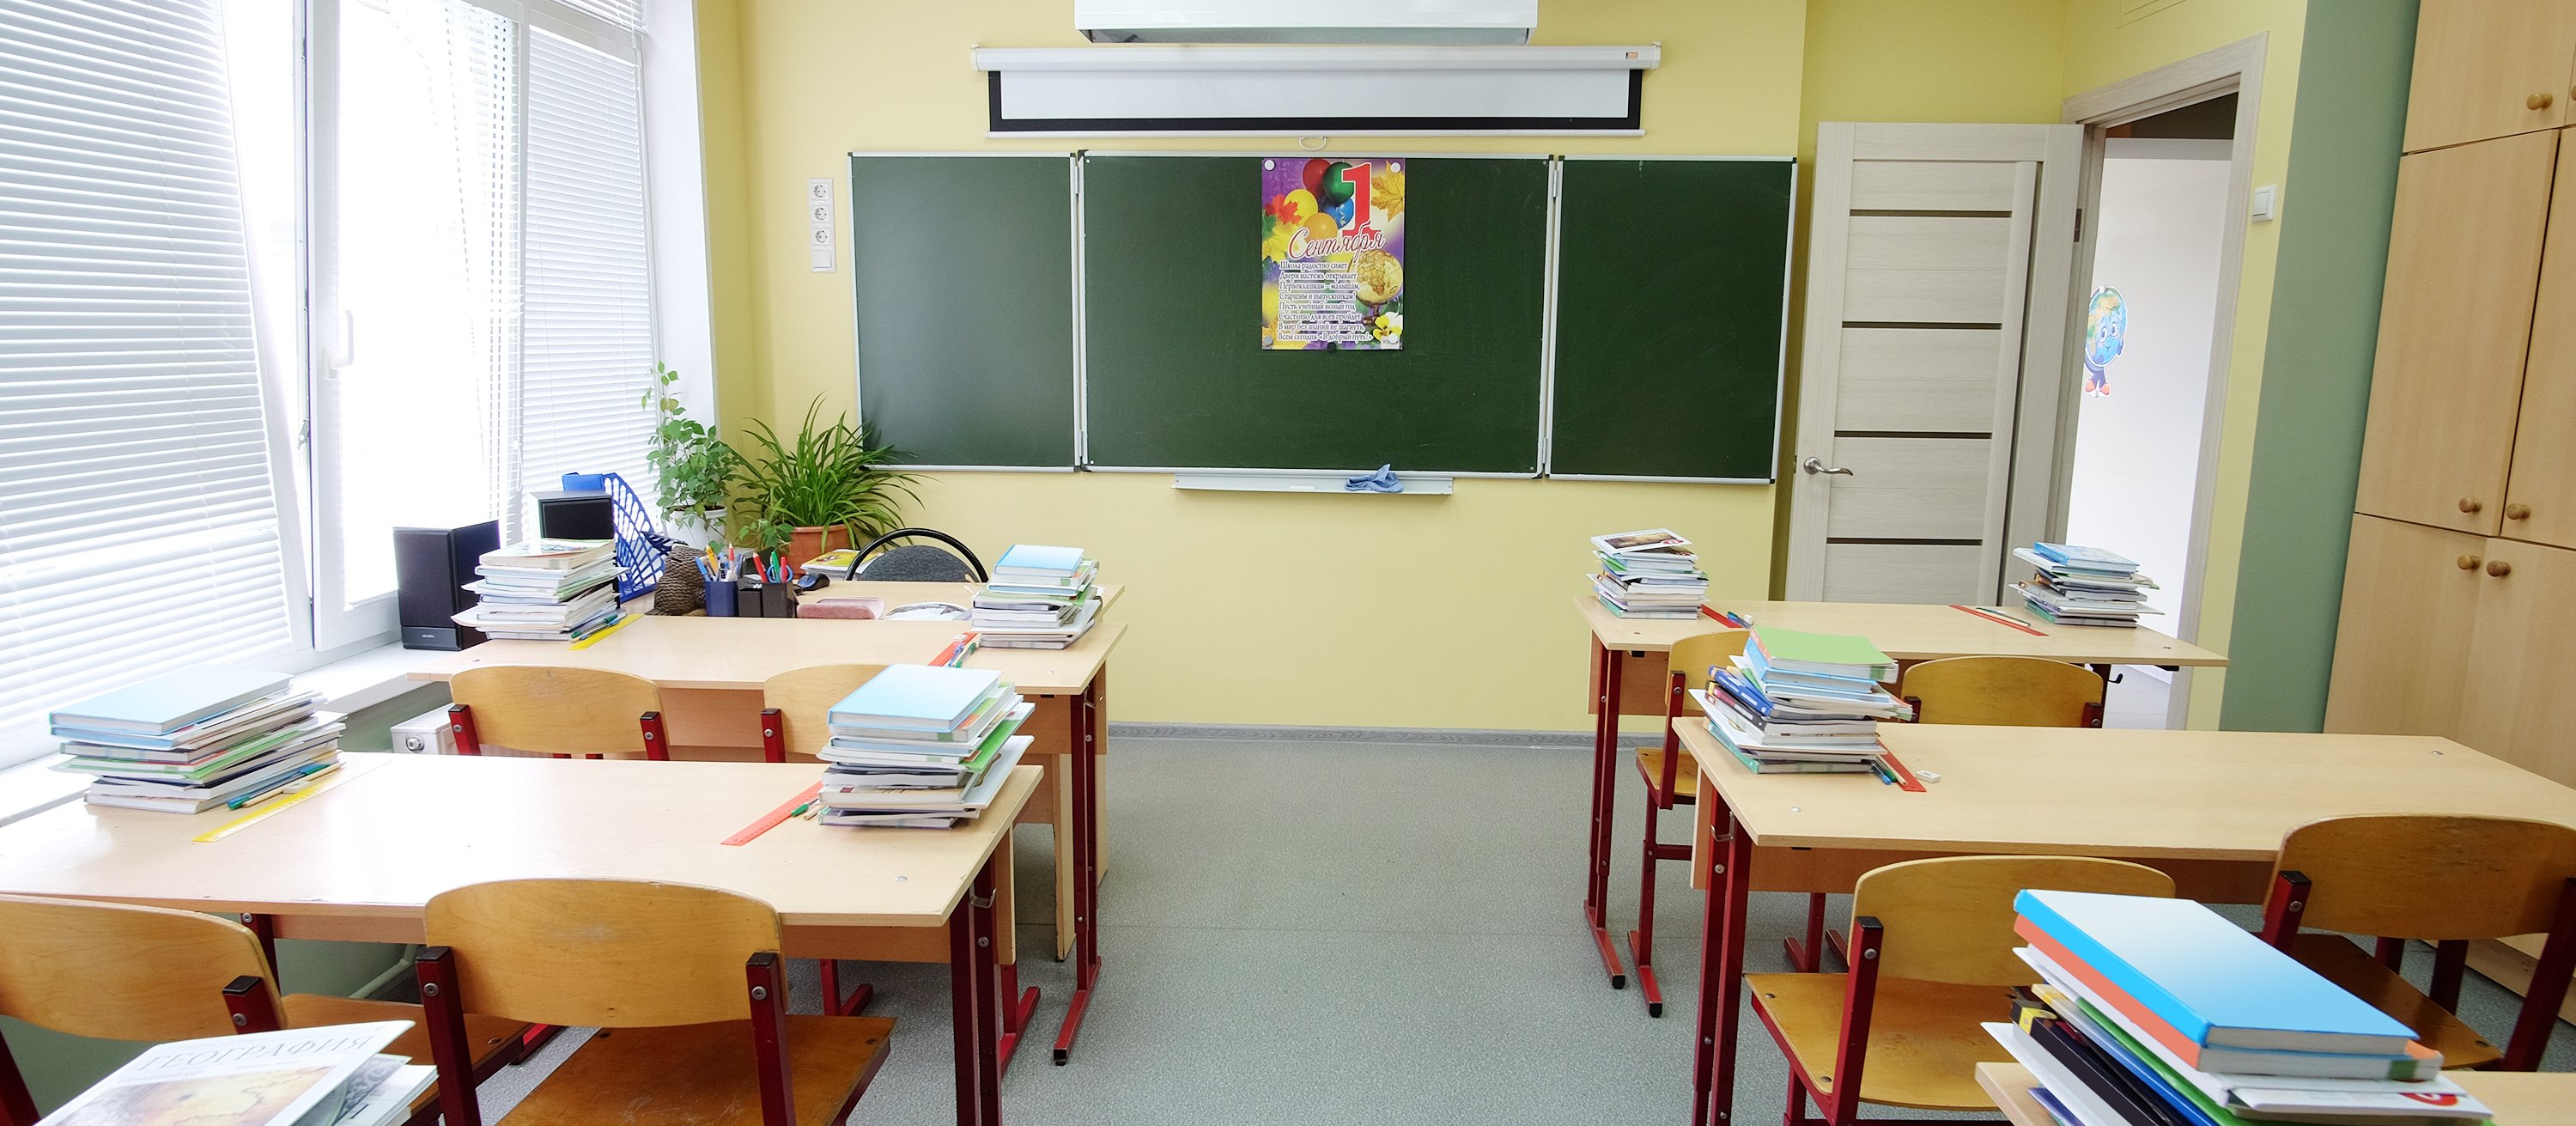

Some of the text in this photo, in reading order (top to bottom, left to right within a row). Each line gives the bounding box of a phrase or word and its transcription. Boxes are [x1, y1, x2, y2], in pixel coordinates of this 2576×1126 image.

[1341, 162, 1382, 240] 1
[1289, 222, 1385, 263] Сентября
[1279, 302, 1297, 312] Пусть
[138, 1035, 374, 1071] ГЕОГРАФИЯ
